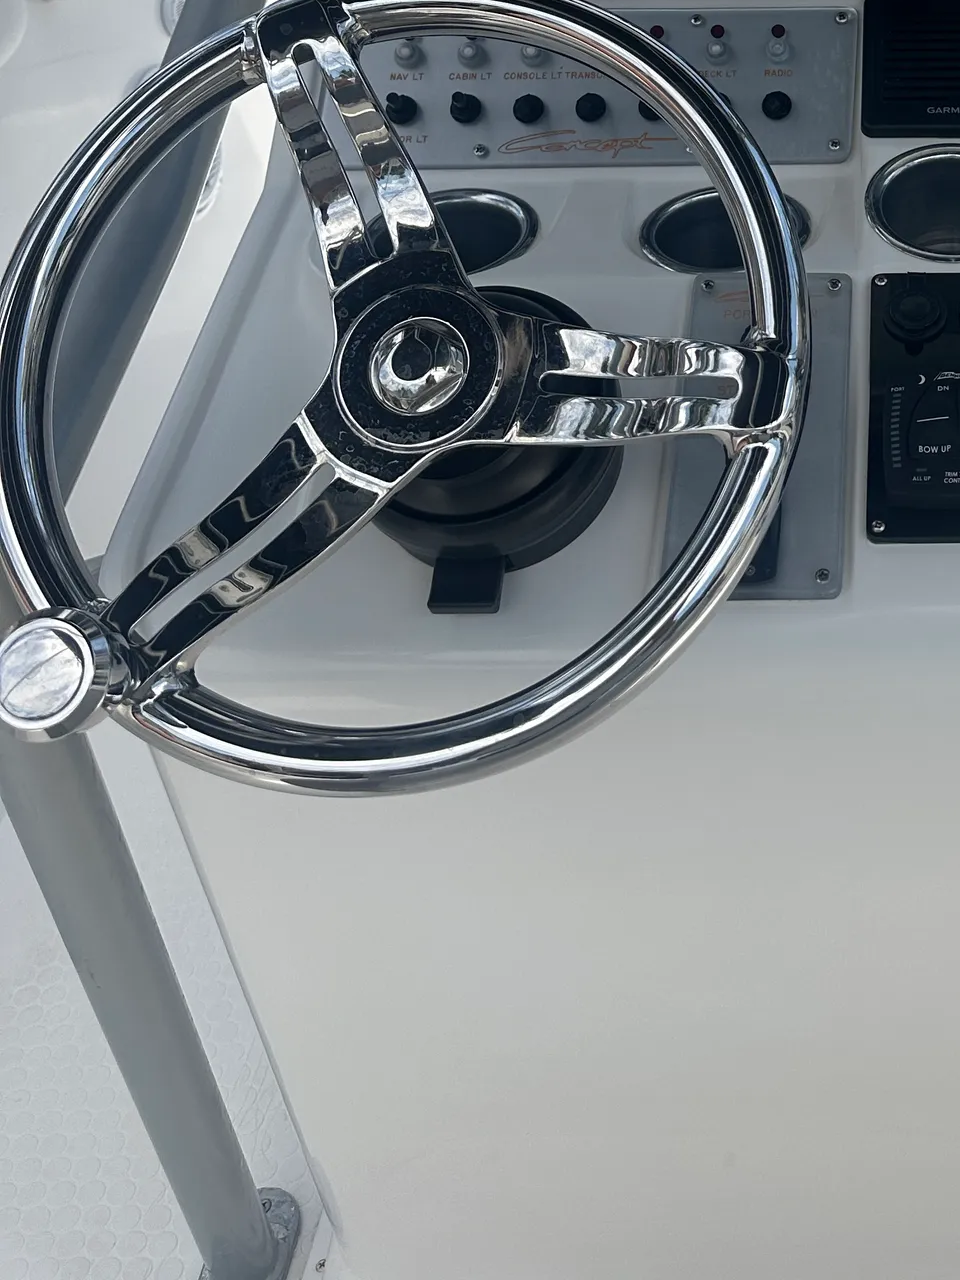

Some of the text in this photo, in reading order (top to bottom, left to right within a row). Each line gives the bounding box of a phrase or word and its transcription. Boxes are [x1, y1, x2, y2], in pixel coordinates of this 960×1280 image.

[390, 72, 424, 80] NAV LT
[449, 72, 492, 81] CABIN LT
[503, 72, 562, 80] CONSOLE LT
[562, 71, 605, 80] TRANSO
[726, 70, 737, 78] LT
[764, 69, 793, 77] RADIO
[416, 135, 428, 143] LT
[918, 445, 952, 453] BOW UP
